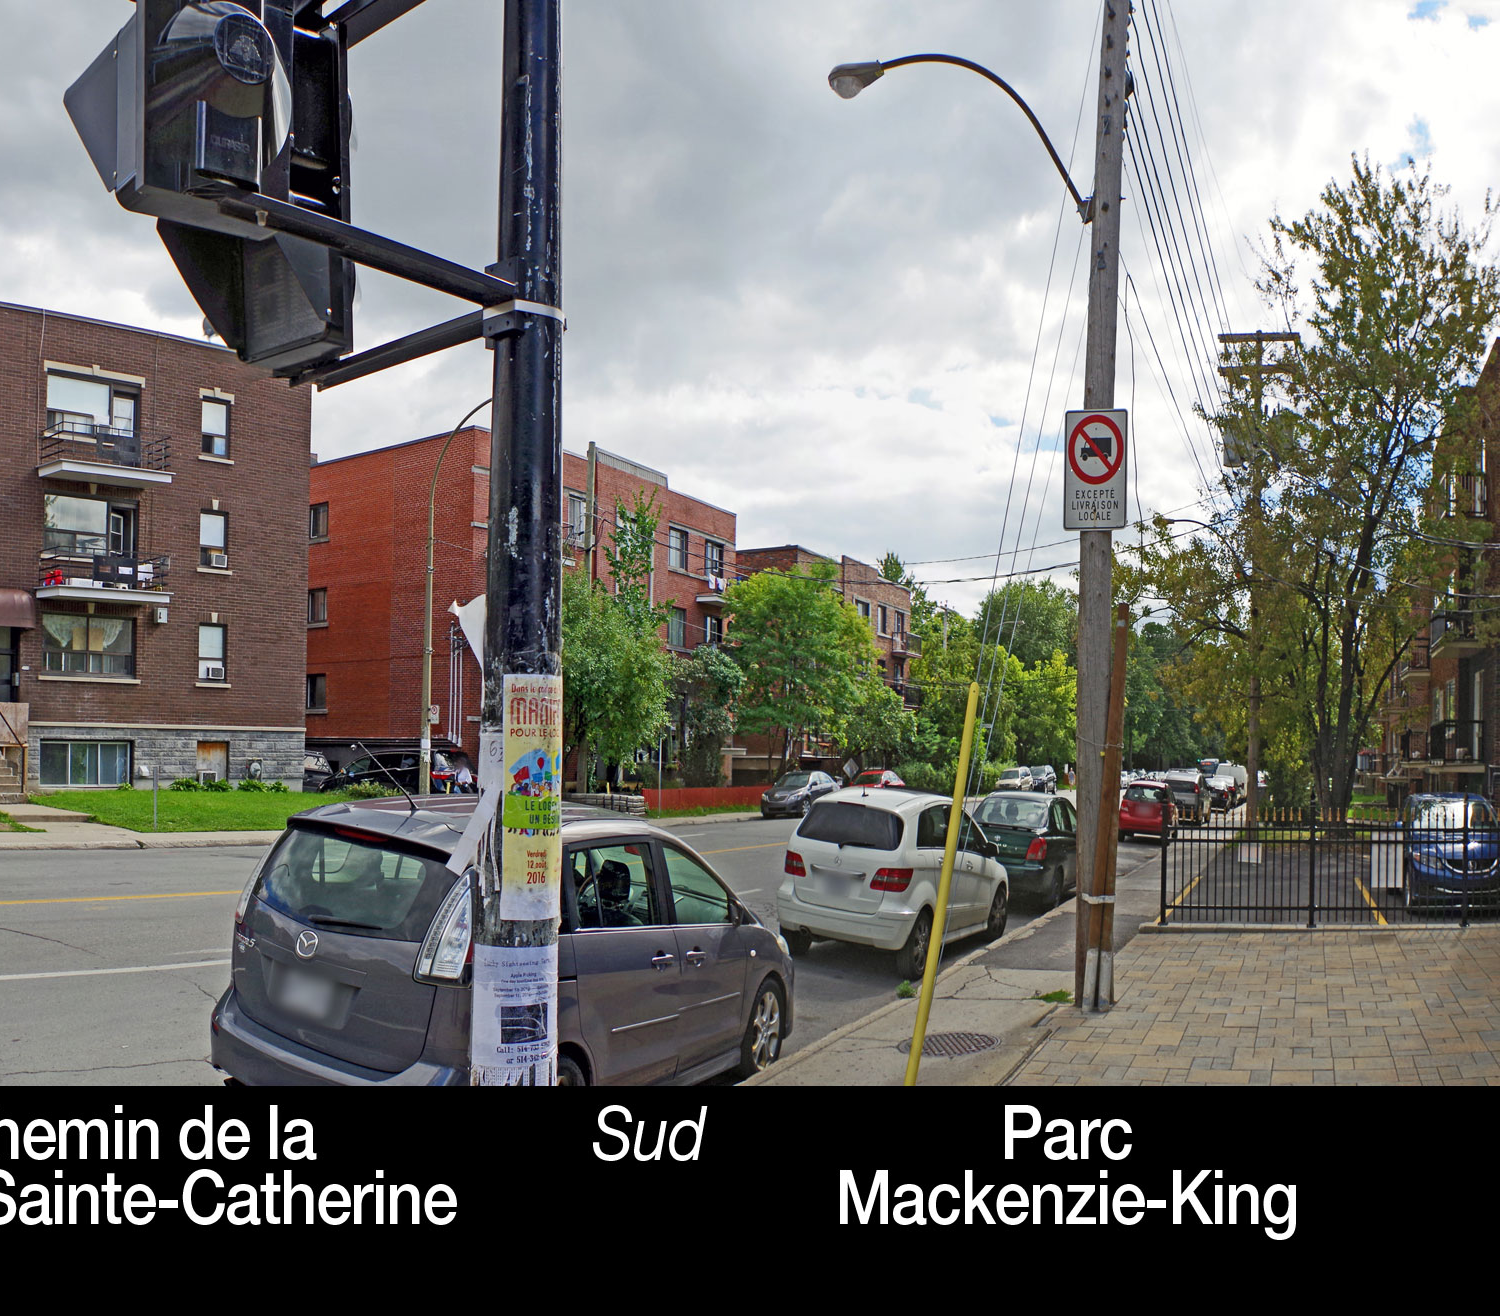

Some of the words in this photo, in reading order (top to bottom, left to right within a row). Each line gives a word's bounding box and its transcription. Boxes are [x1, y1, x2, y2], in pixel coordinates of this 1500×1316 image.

[1075, 488, 1115, 499] EXCEPTÉ
[1071, 501, 1119, 511] LIVRAISON
[1078, 511, 1111, 521] LOCALE
[511, 683, 528, 693] Dans
[510, 728, 536, 737] POUR
[525, 800, 535, 811] LE
[529, 814, 540, 824] UN
[527, 850, 547, 859] Vendredi
[527, 860, 534, 868] 12
[526, 872, 546, 884] 2016
[496, 1046, 514, 1054] Call:
